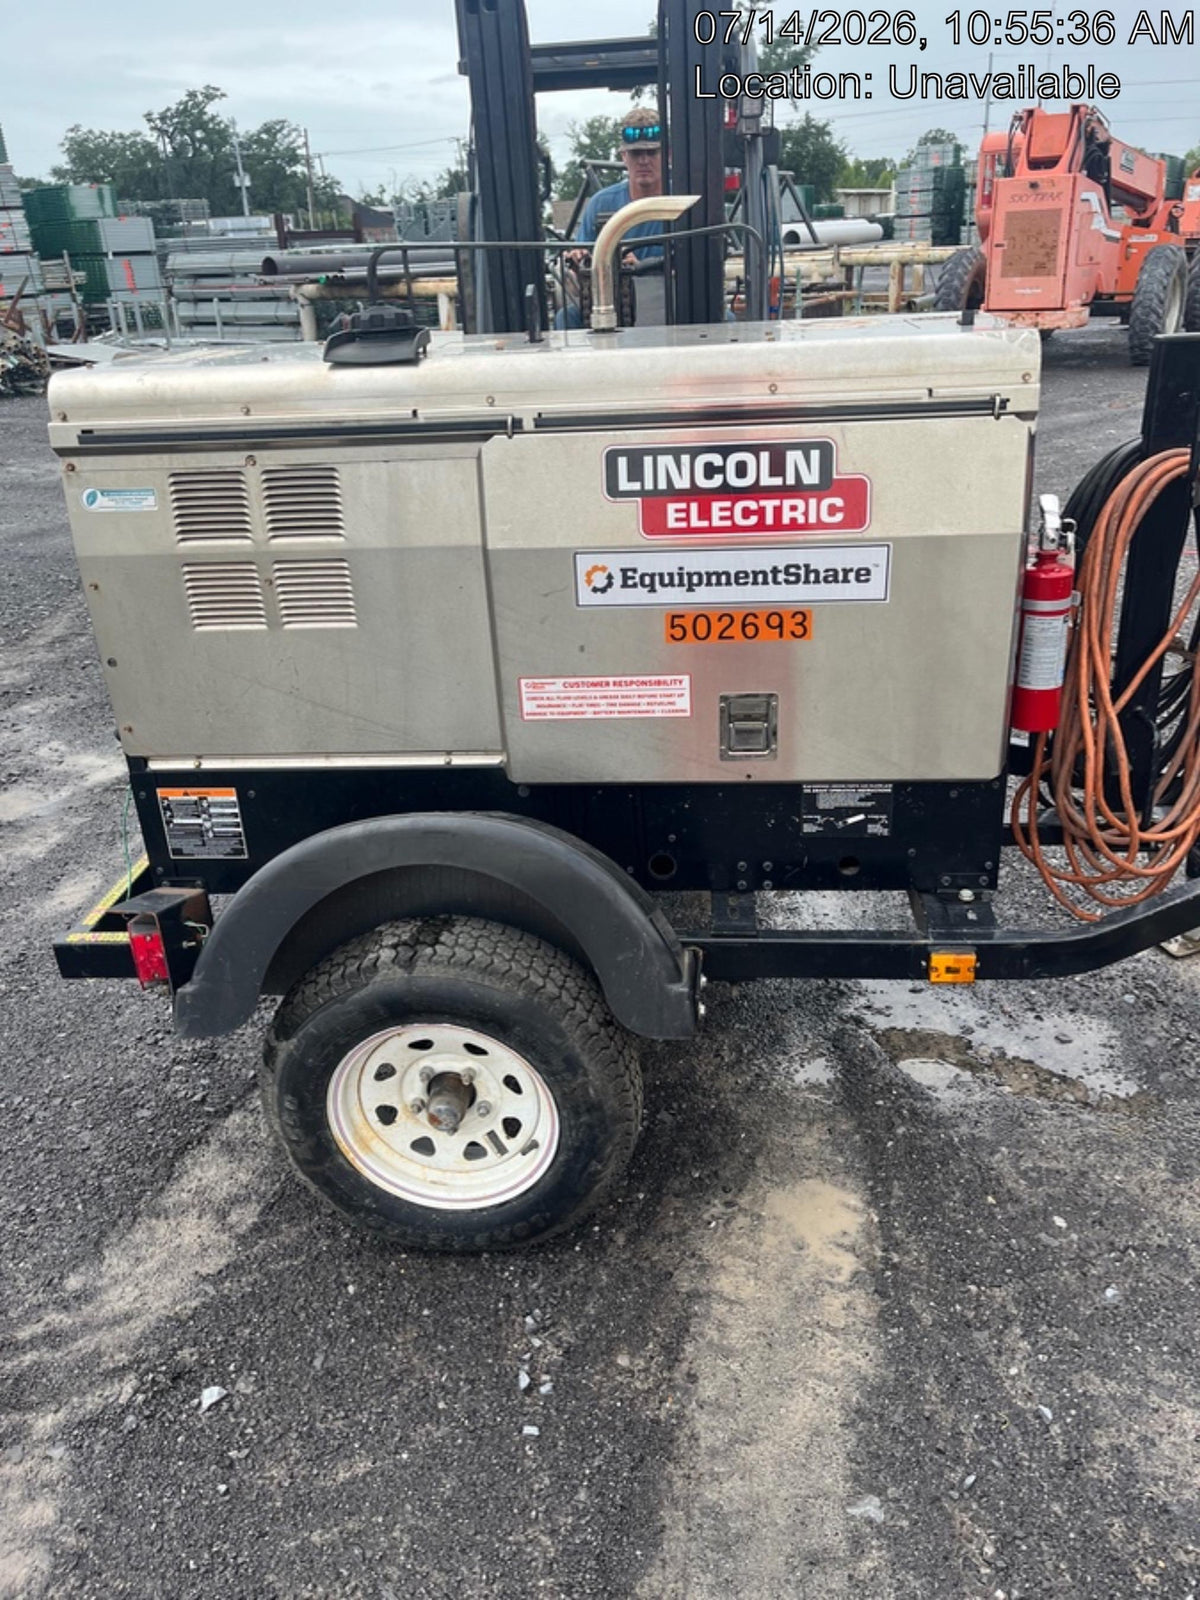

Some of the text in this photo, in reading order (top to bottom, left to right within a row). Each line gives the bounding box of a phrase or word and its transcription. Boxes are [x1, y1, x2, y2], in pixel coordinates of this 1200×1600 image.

[617, 449, 821, 492] LINCOLN
[666, 497, 845, 529] ELECTRIC
[668, 610, 809, 642] 502693
[562, 680, 611, 689] CUSTOMER
[612, 678, 684, 688] RESPONSIBILITY
